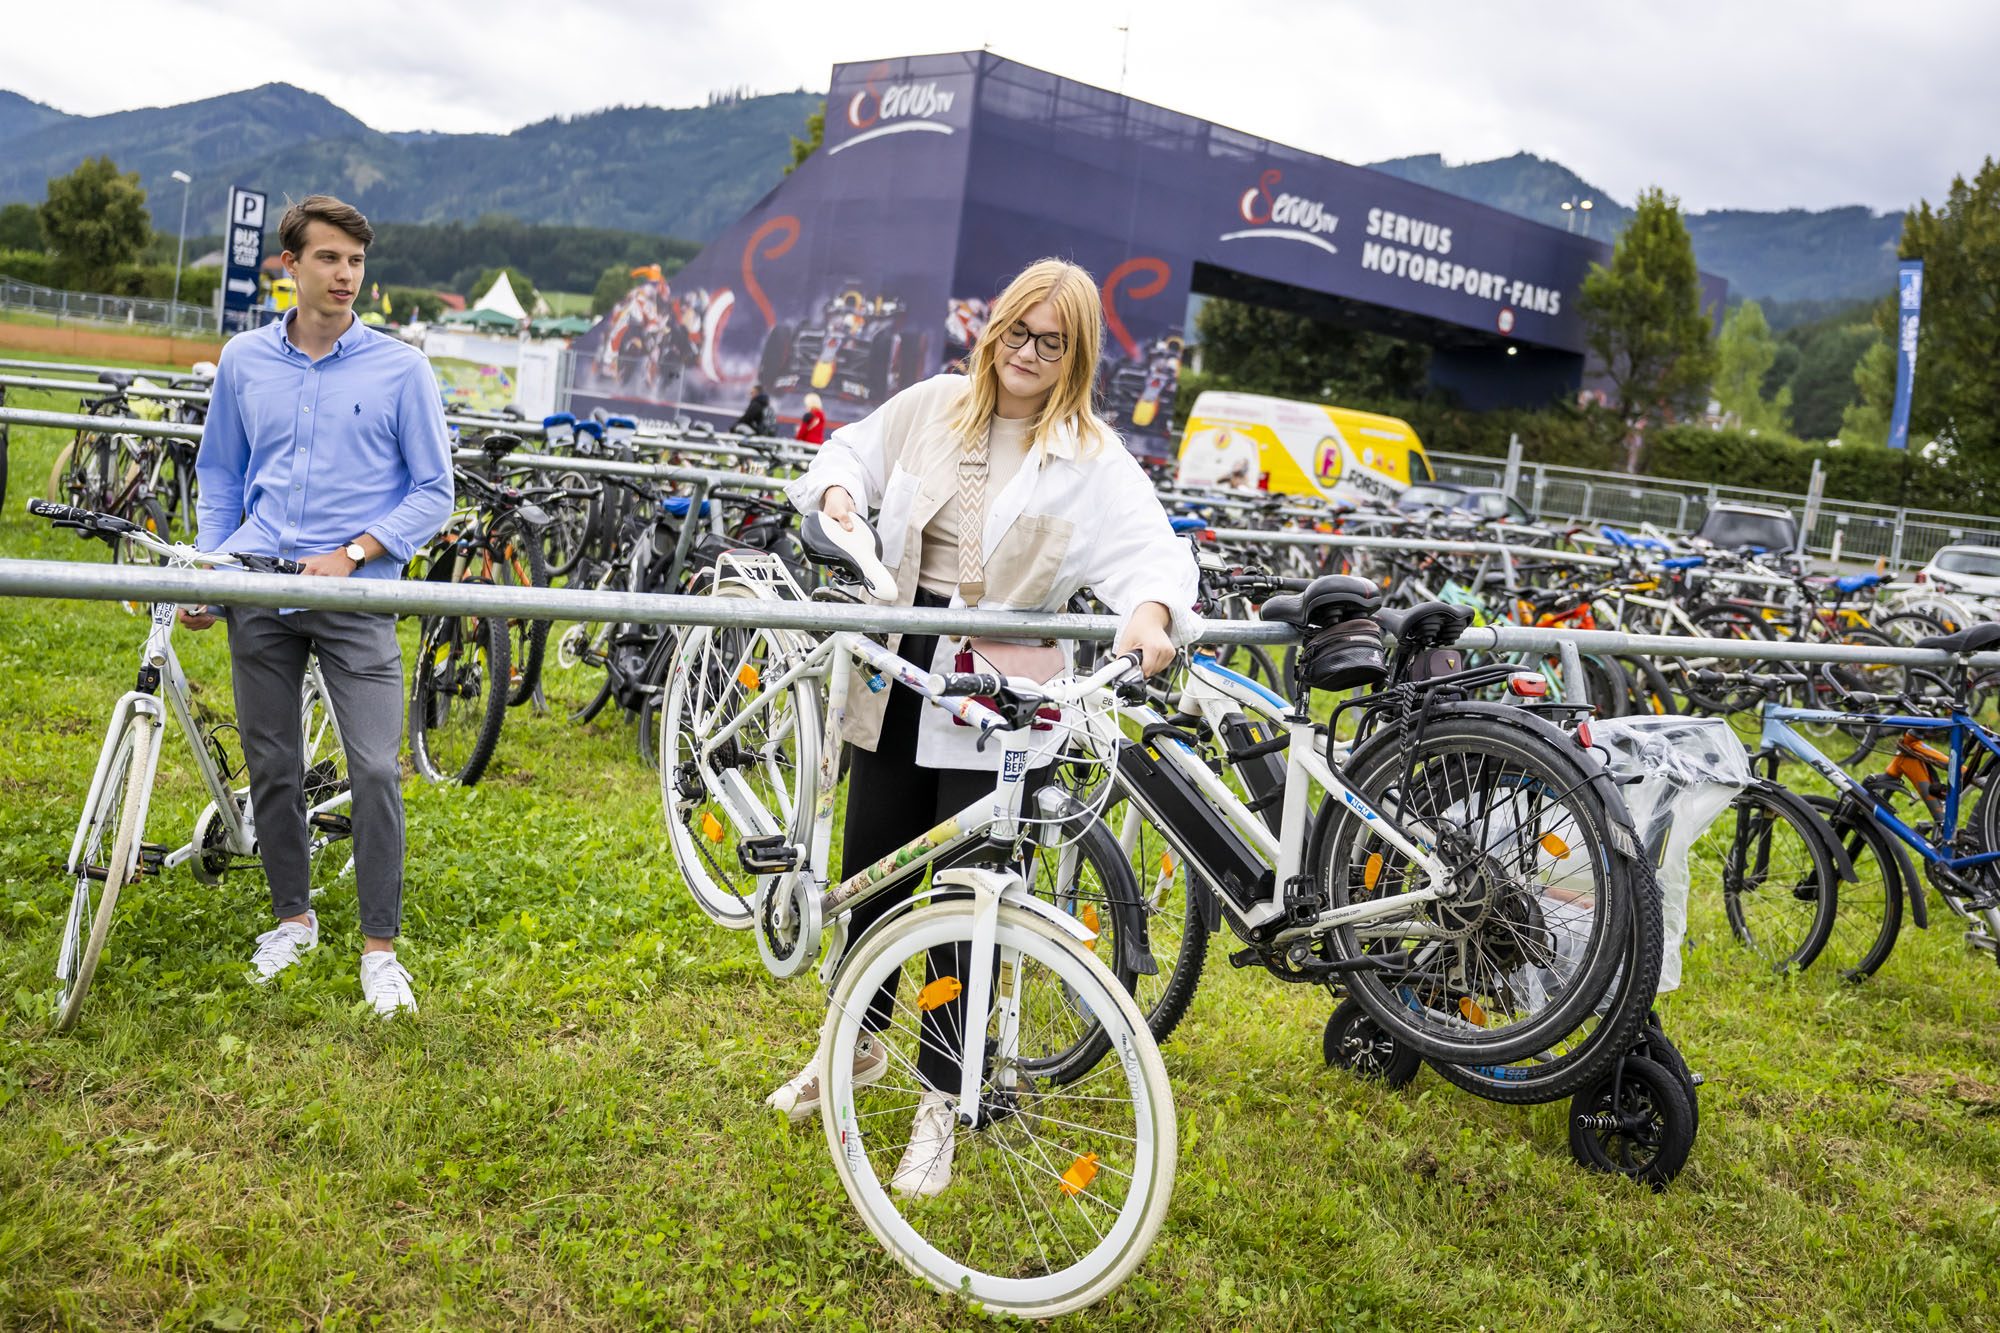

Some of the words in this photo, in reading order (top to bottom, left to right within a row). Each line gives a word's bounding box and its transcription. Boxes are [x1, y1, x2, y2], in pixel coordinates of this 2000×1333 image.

[242, 197, 256, 220] P
[234, 227, 259, 248] BUS
[1366, 207, 1453, 255] SERVUS
[1361, 241, 1562, 316] MOTORSPORT-FANS
[1321, 447, 1337, 477] F
[1102, 697, 1113, 706] 26
[1350, 797, 1370, 817] NCM
